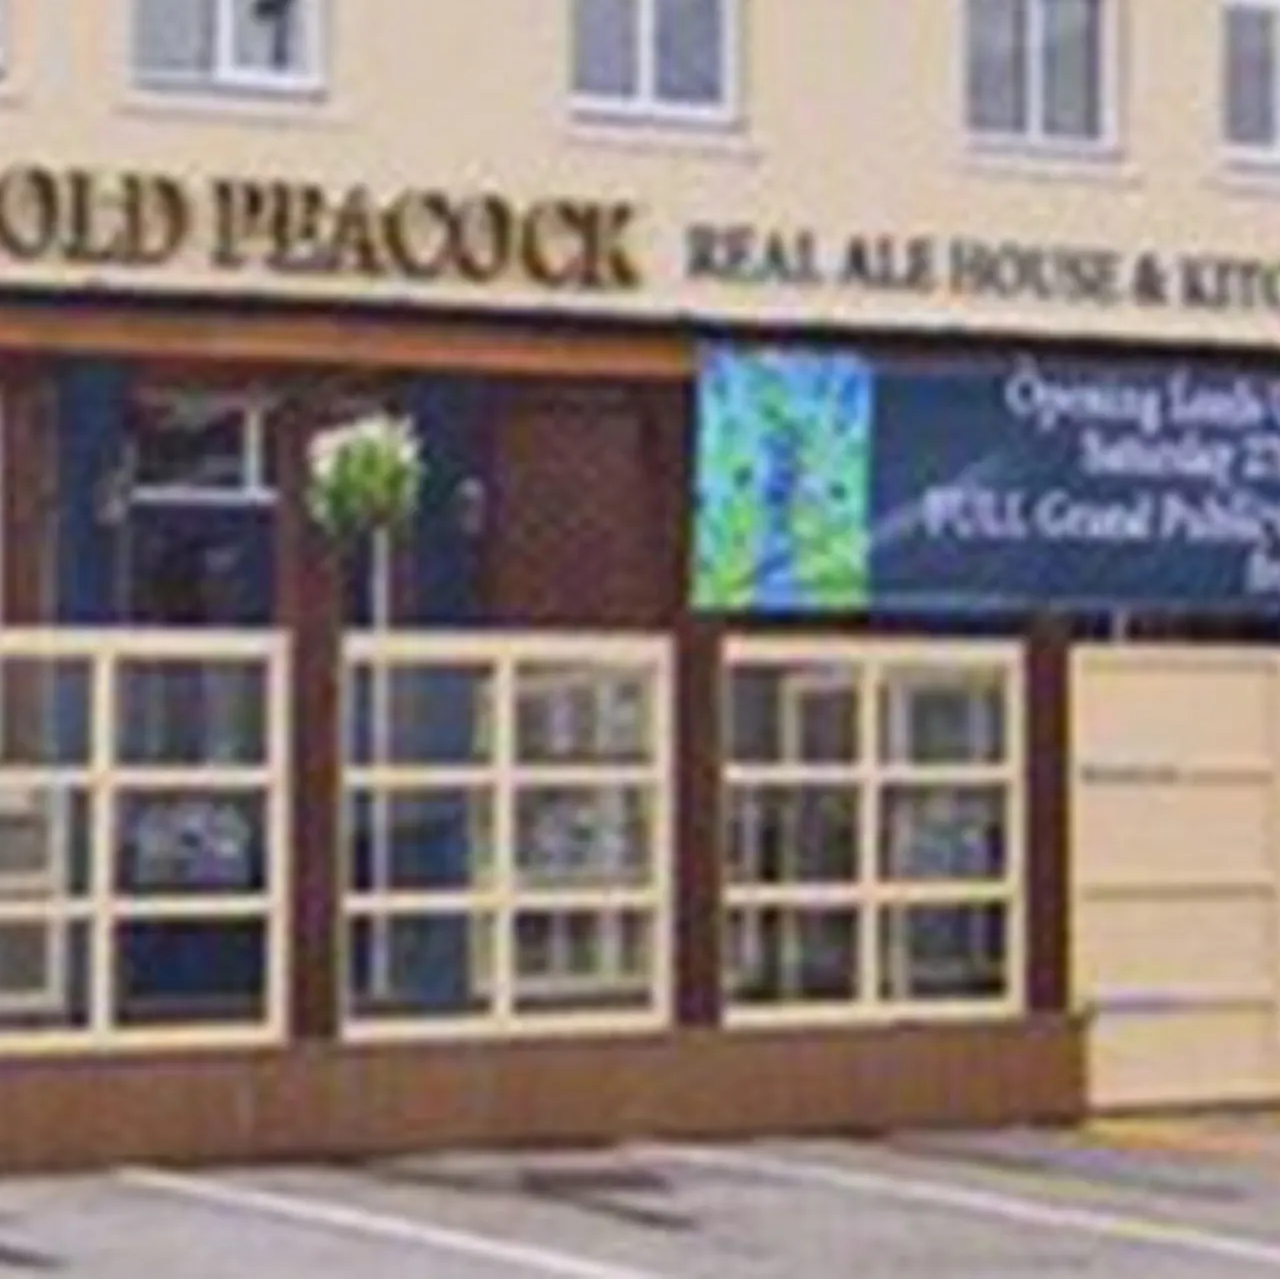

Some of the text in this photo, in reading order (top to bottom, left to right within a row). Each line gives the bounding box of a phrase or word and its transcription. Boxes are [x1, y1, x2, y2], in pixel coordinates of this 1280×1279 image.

[211, 178, 642, 290] PEACOCK
[686, 225, 818, 284] REAL
[838, 230, 932, 294] ALE
[949, 233, 1122, 304] HOUSE
[1131, 250, 1170, 308] &
